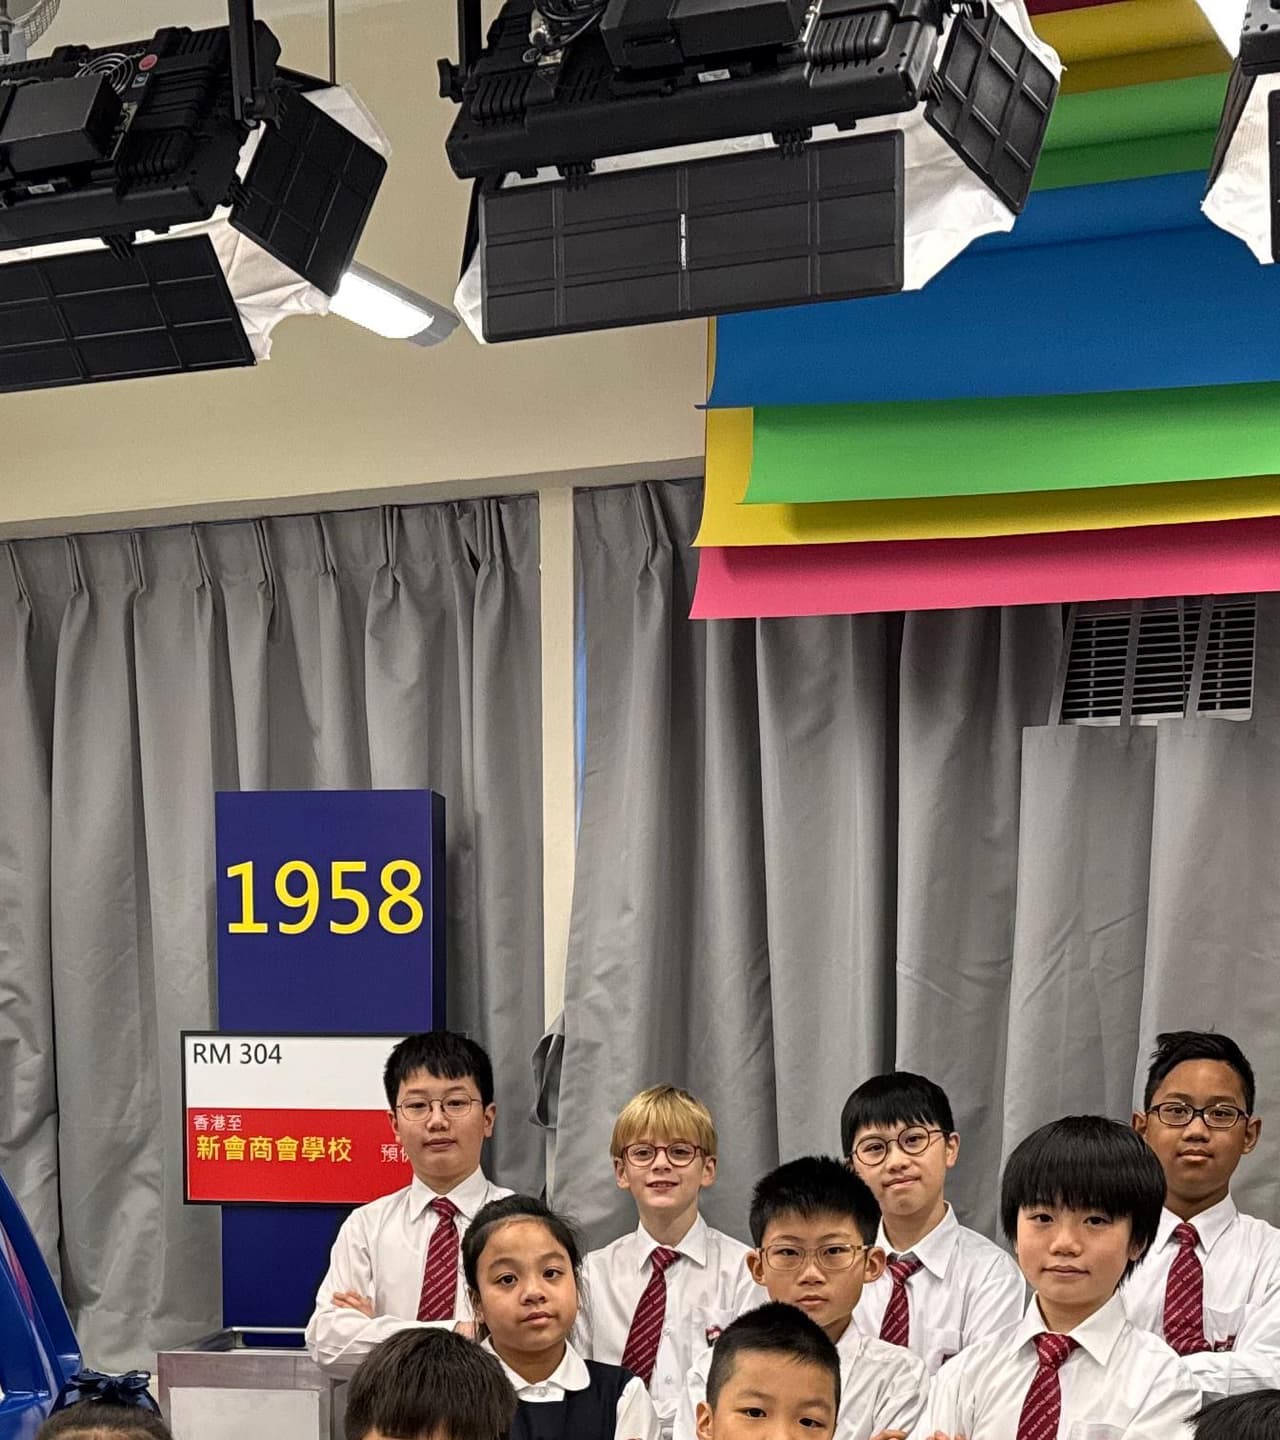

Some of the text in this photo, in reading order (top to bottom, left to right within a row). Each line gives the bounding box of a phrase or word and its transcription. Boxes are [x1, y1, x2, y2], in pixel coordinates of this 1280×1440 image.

[226, 859, 424, 935] 1958
[193, 1043, 282, 1064] RM 304
[193, 1114, 242, 1131] 香港至
[196, 1135, 352, 1162] 新會商會學校
